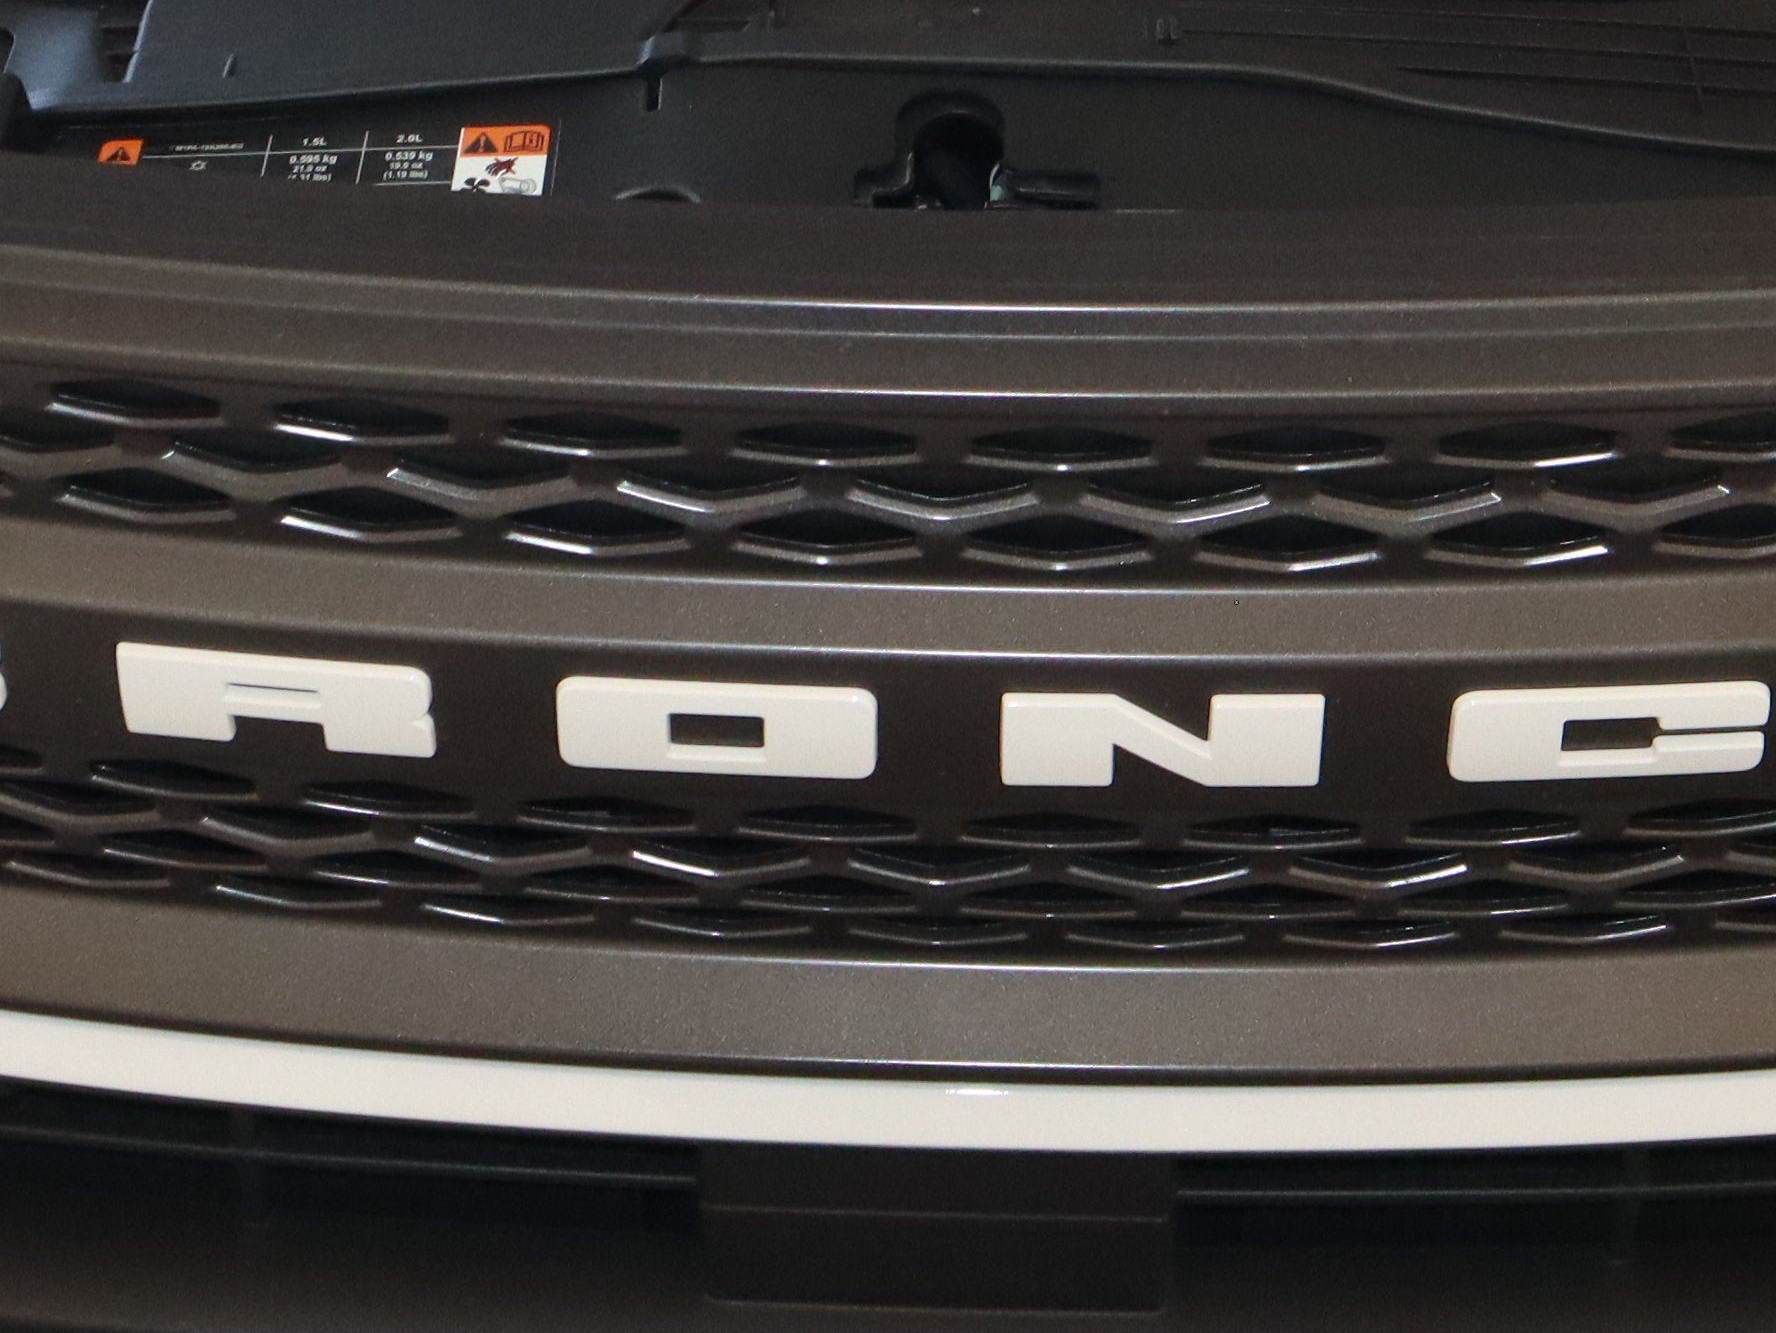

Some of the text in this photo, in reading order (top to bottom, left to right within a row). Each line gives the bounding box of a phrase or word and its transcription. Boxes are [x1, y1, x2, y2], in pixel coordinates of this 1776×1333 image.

[302, 136, 328, 147] 1.5L
[395, 134, 423, 144] 2.0L
[322, 154, 339, 166] kg
[418, 150, 435, 163] kg
